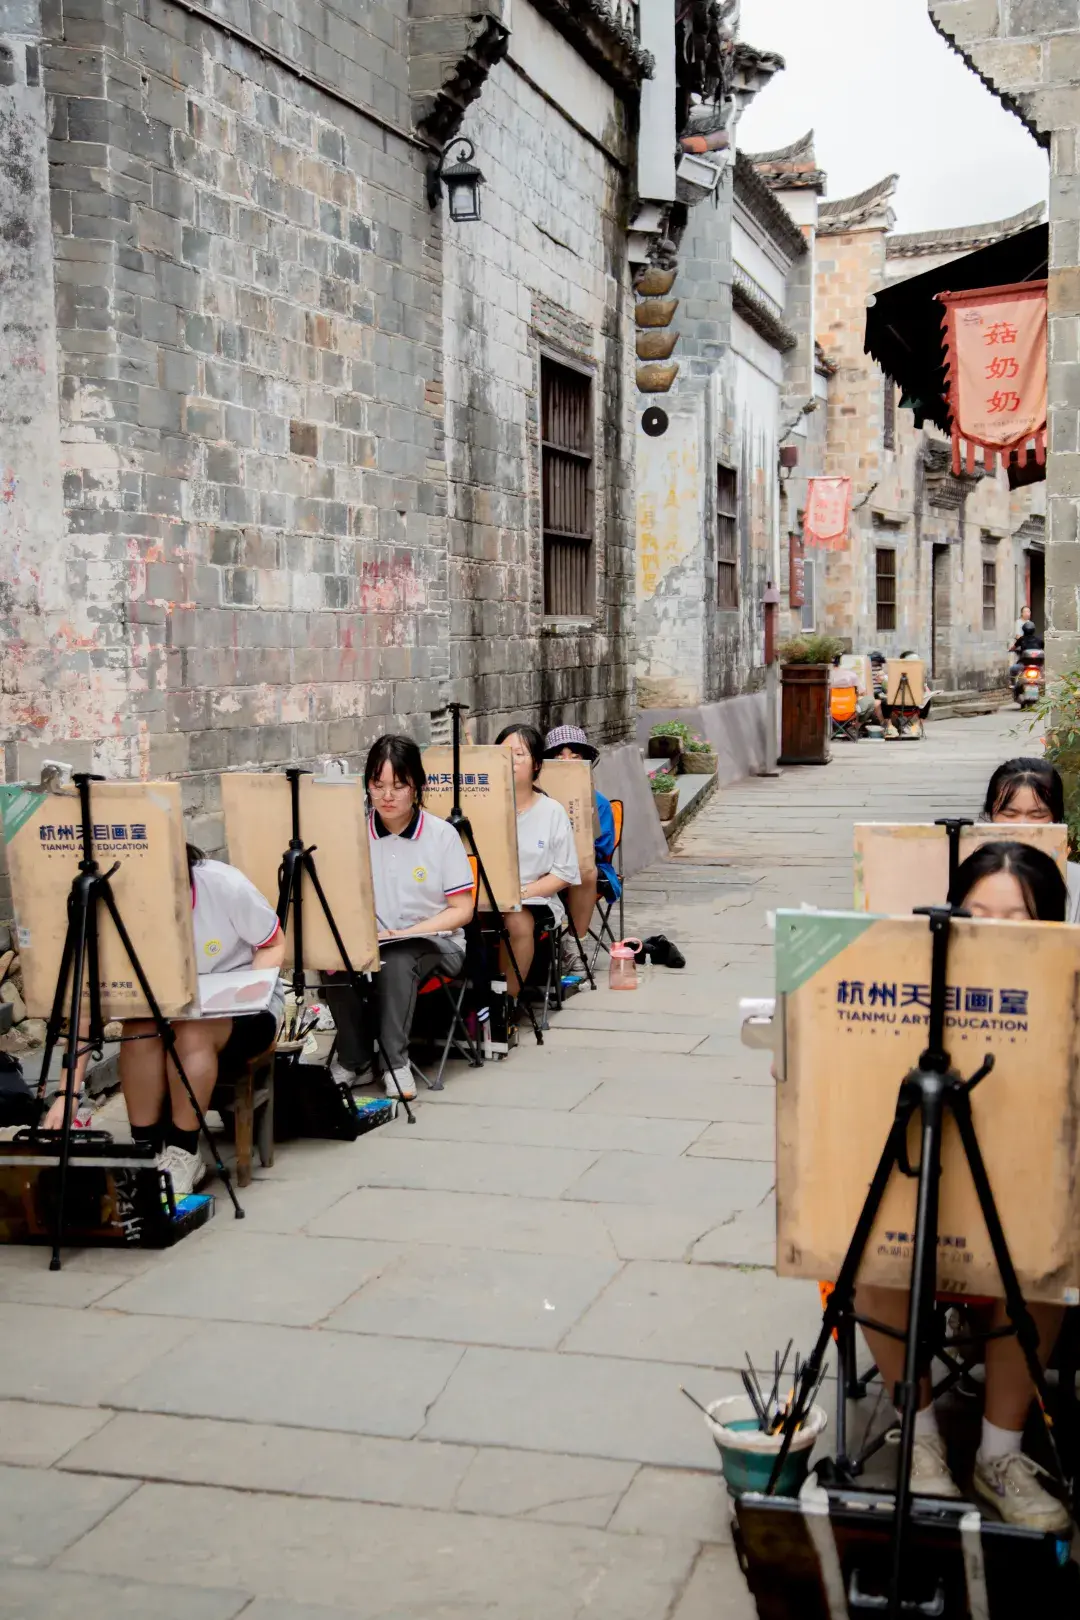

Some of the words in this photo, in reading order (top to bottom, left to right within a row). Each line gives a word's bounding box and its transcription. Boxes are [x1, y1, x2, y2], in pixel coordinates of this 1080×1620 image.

[983, 322, 1021, 414] 菇奶奶
[40, 843, 76, 851] TIANMU
[97, 843, 149, 851] EDUCATION
[837, 1010, 897, 1024] TIANMU
[901, 1013, 931, 1026] ART
[946, 1018, 1029, 1032] DUCATION
